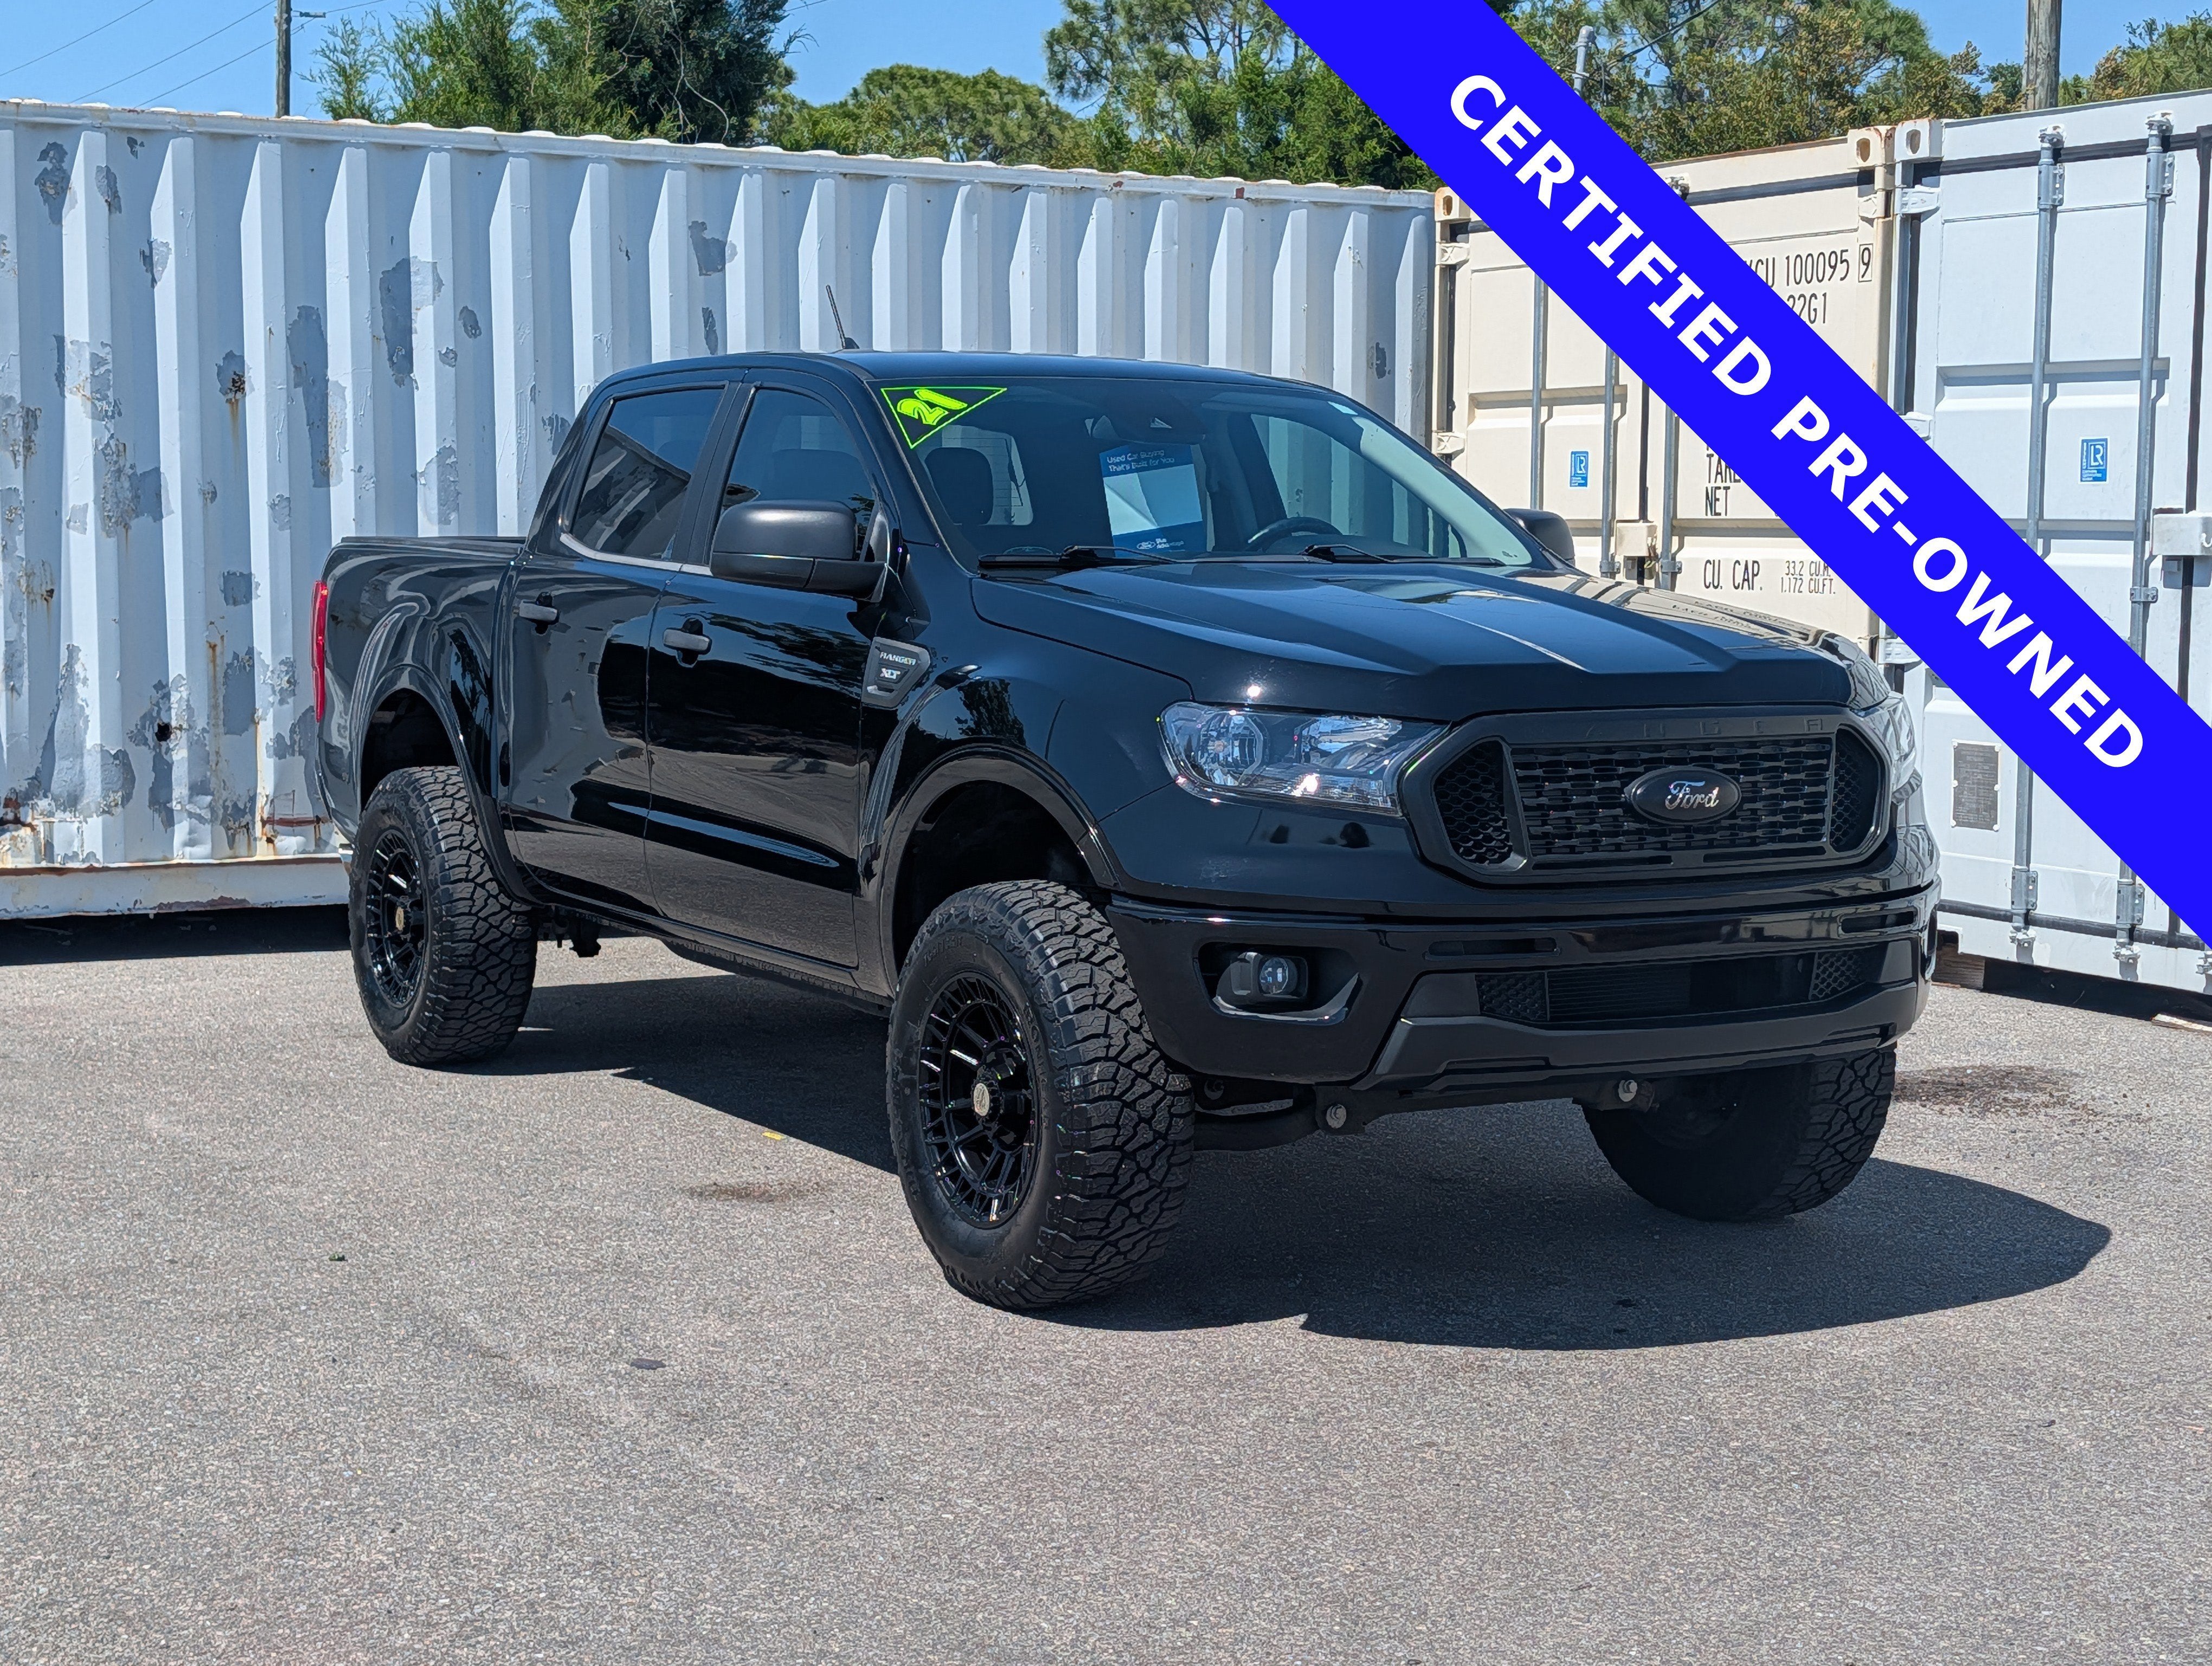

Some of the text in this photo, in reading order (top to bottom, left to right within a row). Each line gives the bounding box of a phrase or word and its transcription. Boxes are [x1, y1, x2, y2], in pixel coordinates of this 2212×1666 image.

[1785, 248, 1850, 286] 100095
[1860, 246, 1872, 279] 9
[897, 388, 968, 425] 21
[1705, 486, 1731, 516] NET
[1703, 559, 1763, 591] CU. CAP.
[1785, 560, 1804, 576] 33.2
[1780, 576, 1803, 593] 1.172
[879, 651, 916, 666] RANGER
[879, 668, 901, 680] XLT
[1665, 780, 1719, 810] Ford
